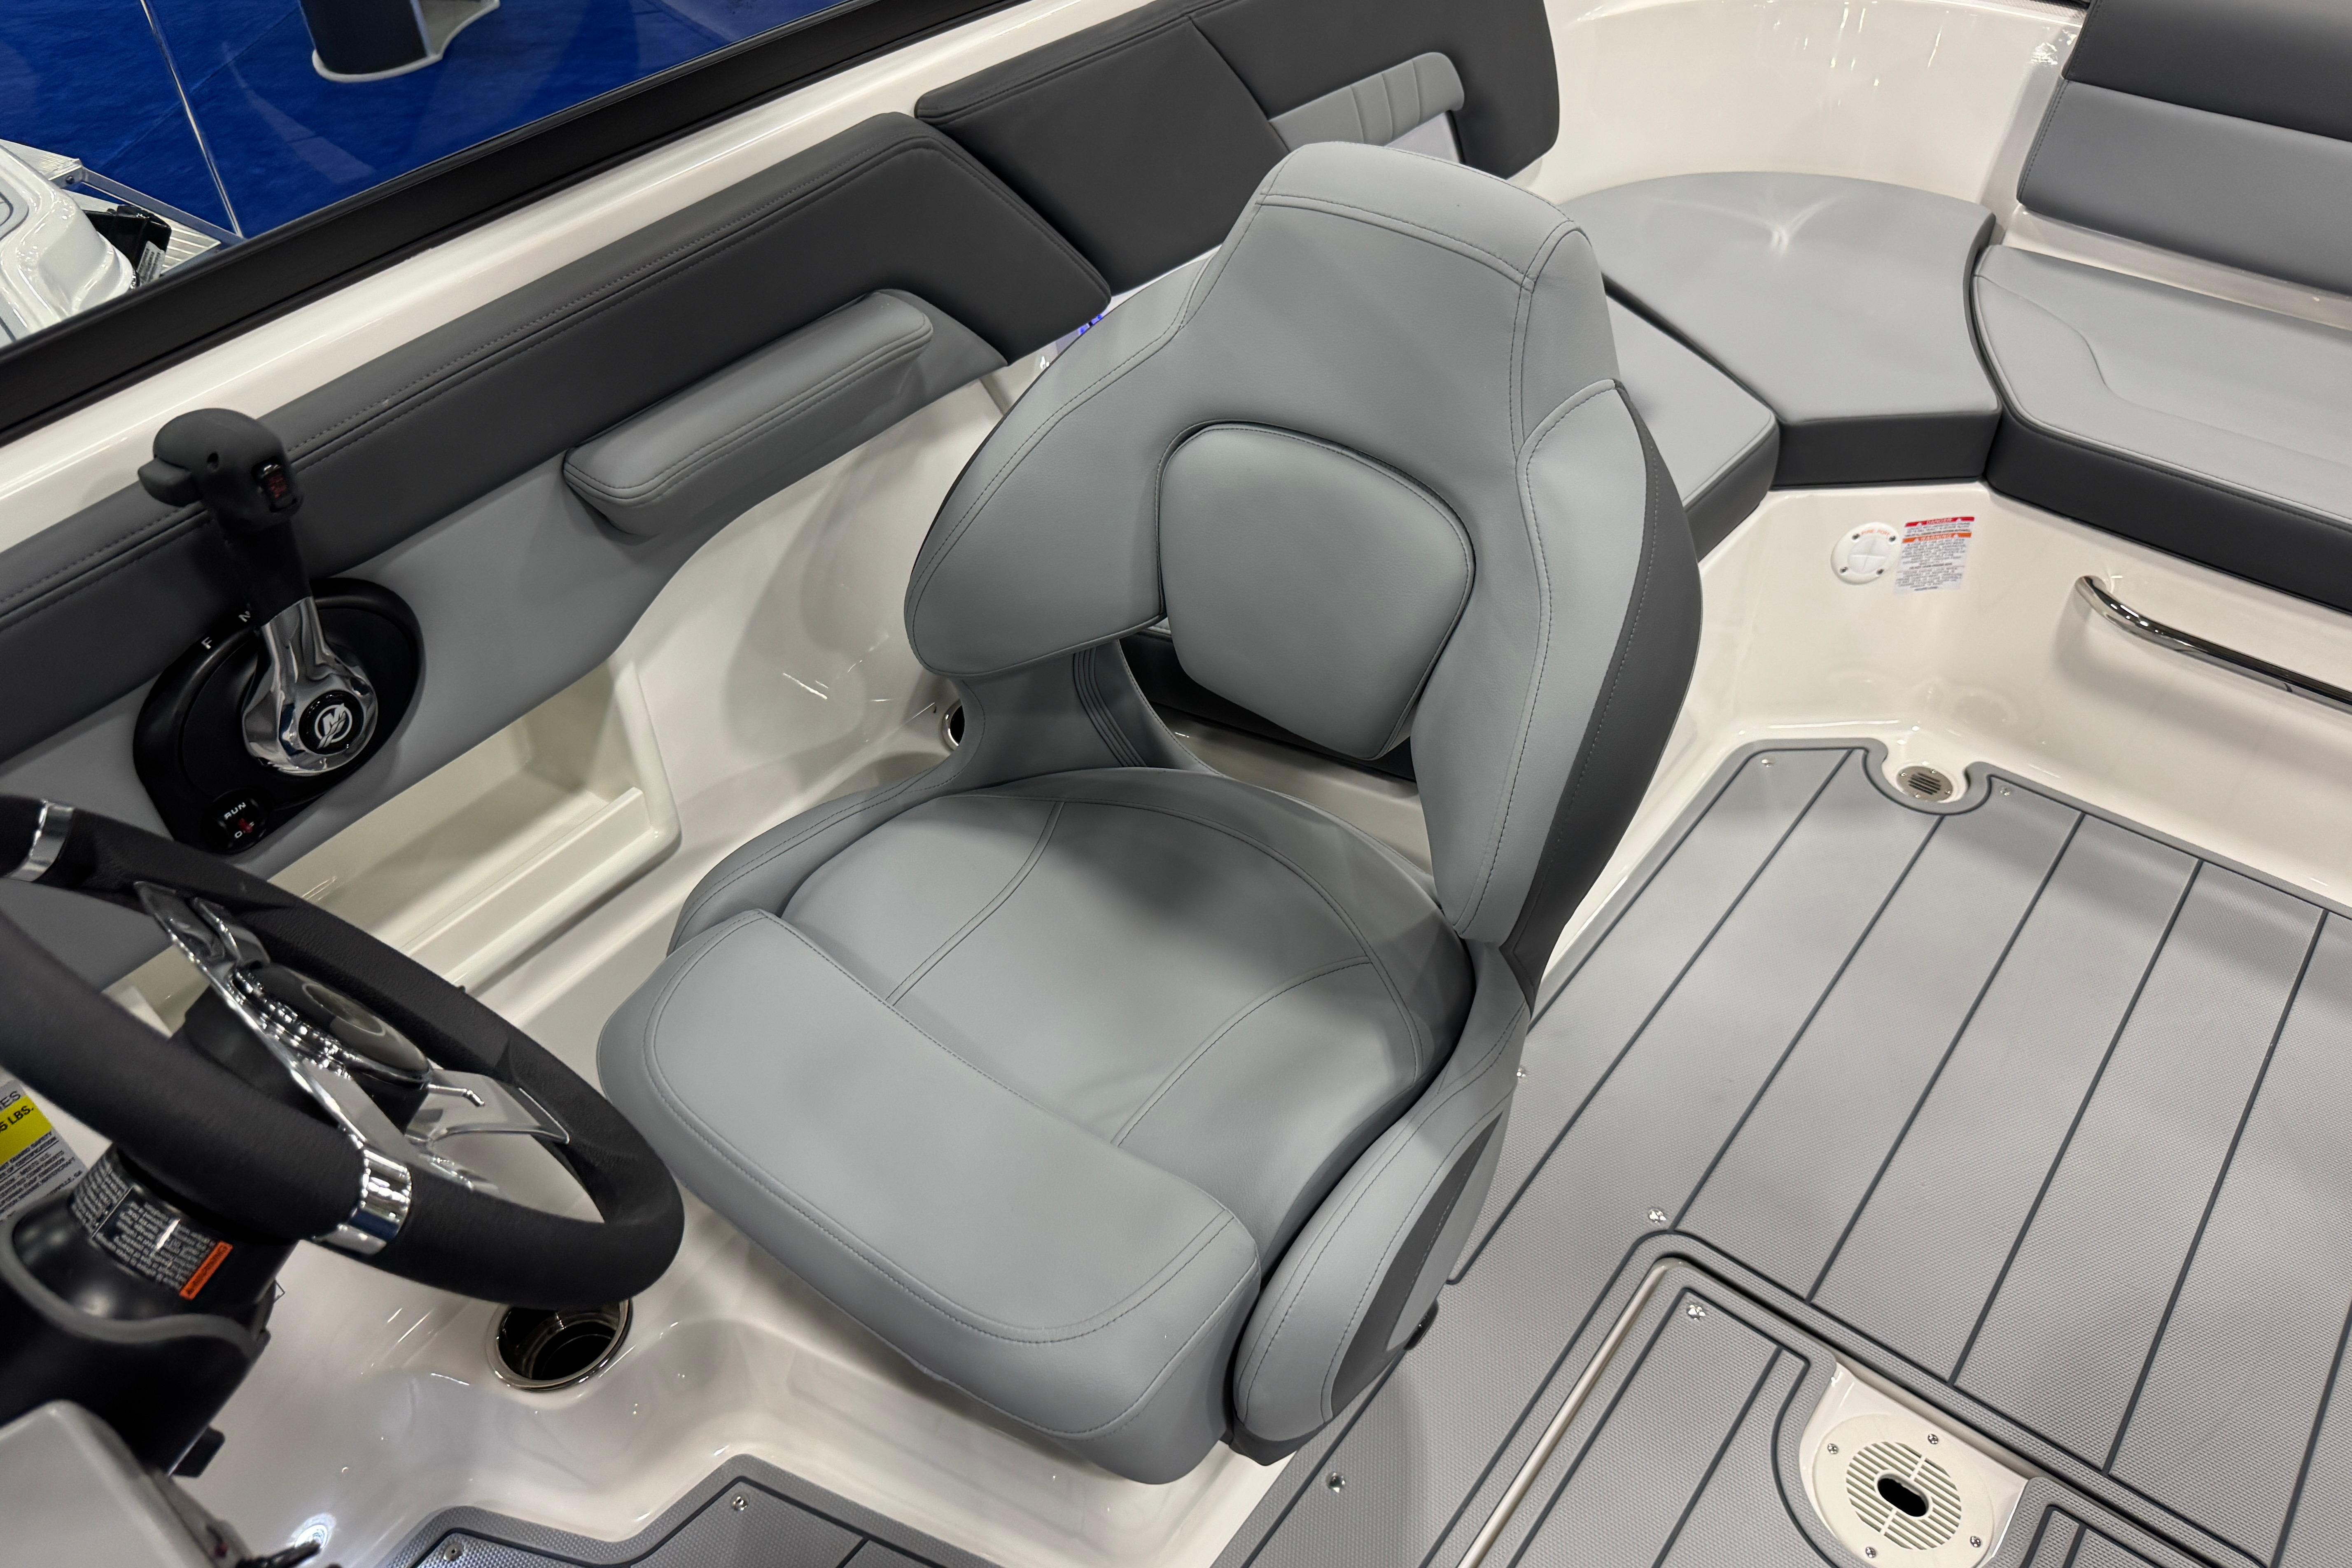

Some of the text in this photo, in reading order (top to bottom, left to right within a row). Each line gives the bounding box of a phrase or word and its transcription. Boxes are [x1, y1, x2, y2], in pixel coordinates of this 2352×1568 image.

[201, 637, 212, 649] F
[224, 802, 246, 820] RUN
[0, 1091, 21, 1111] ES
[7, 1106, 34, 1125] LBS.
